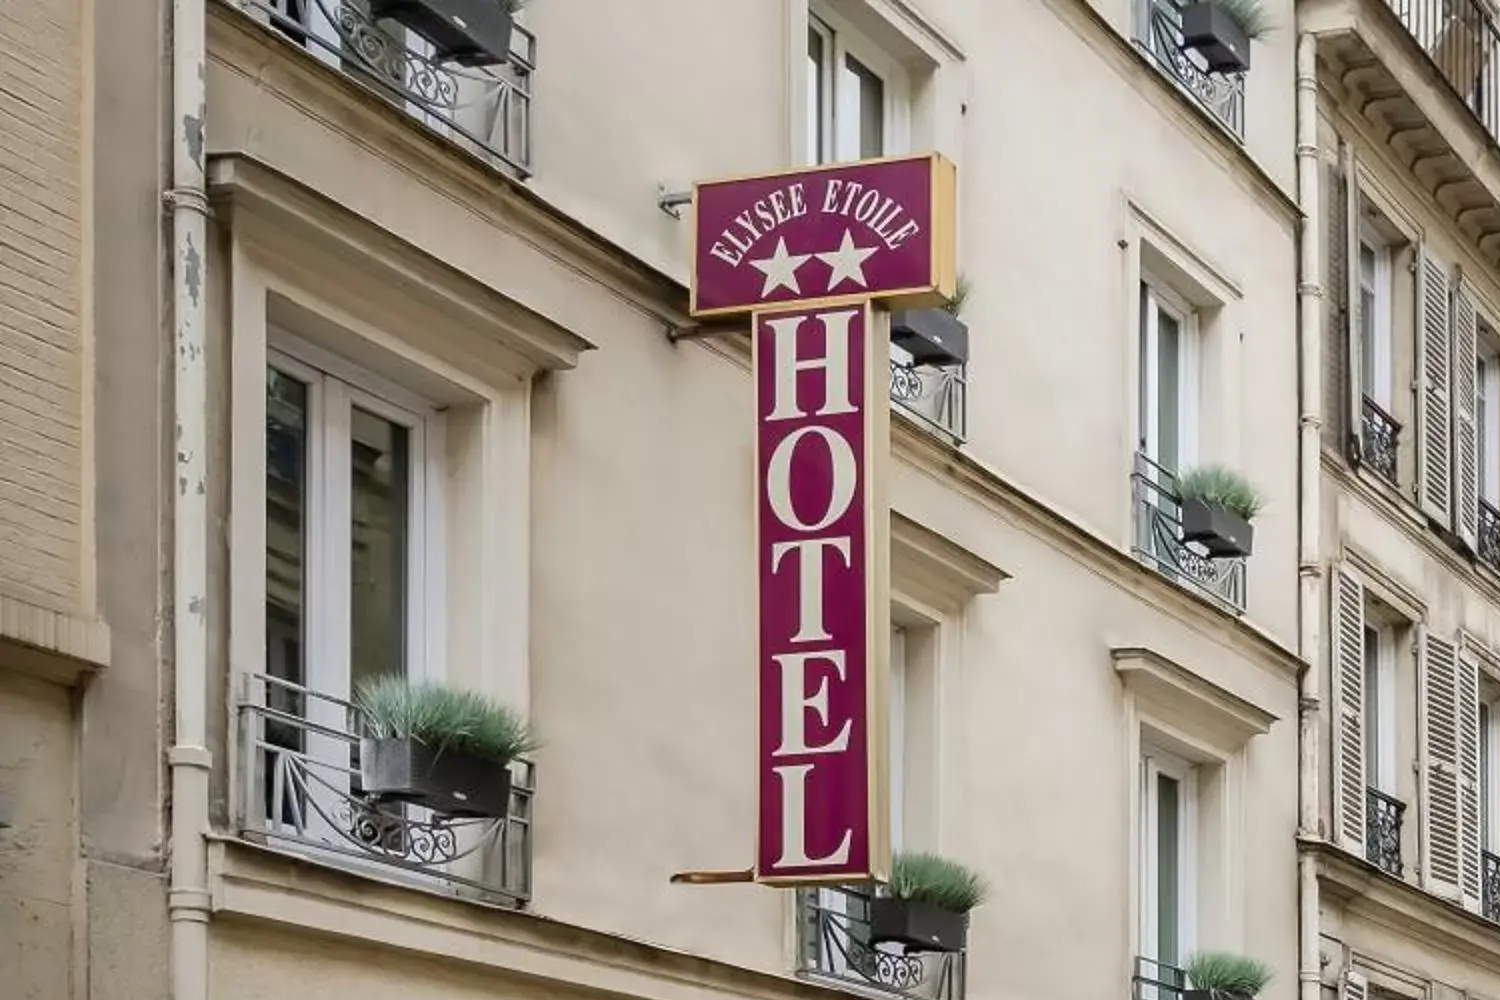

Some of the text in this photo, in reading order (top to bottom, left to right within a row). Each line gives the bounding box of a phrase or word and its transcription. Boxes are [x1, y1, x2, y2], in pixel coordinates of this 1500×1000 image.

[709, 178, 920, 268] ELYSEE ETOILE
[764, 309, 859, 870] HOTEL
